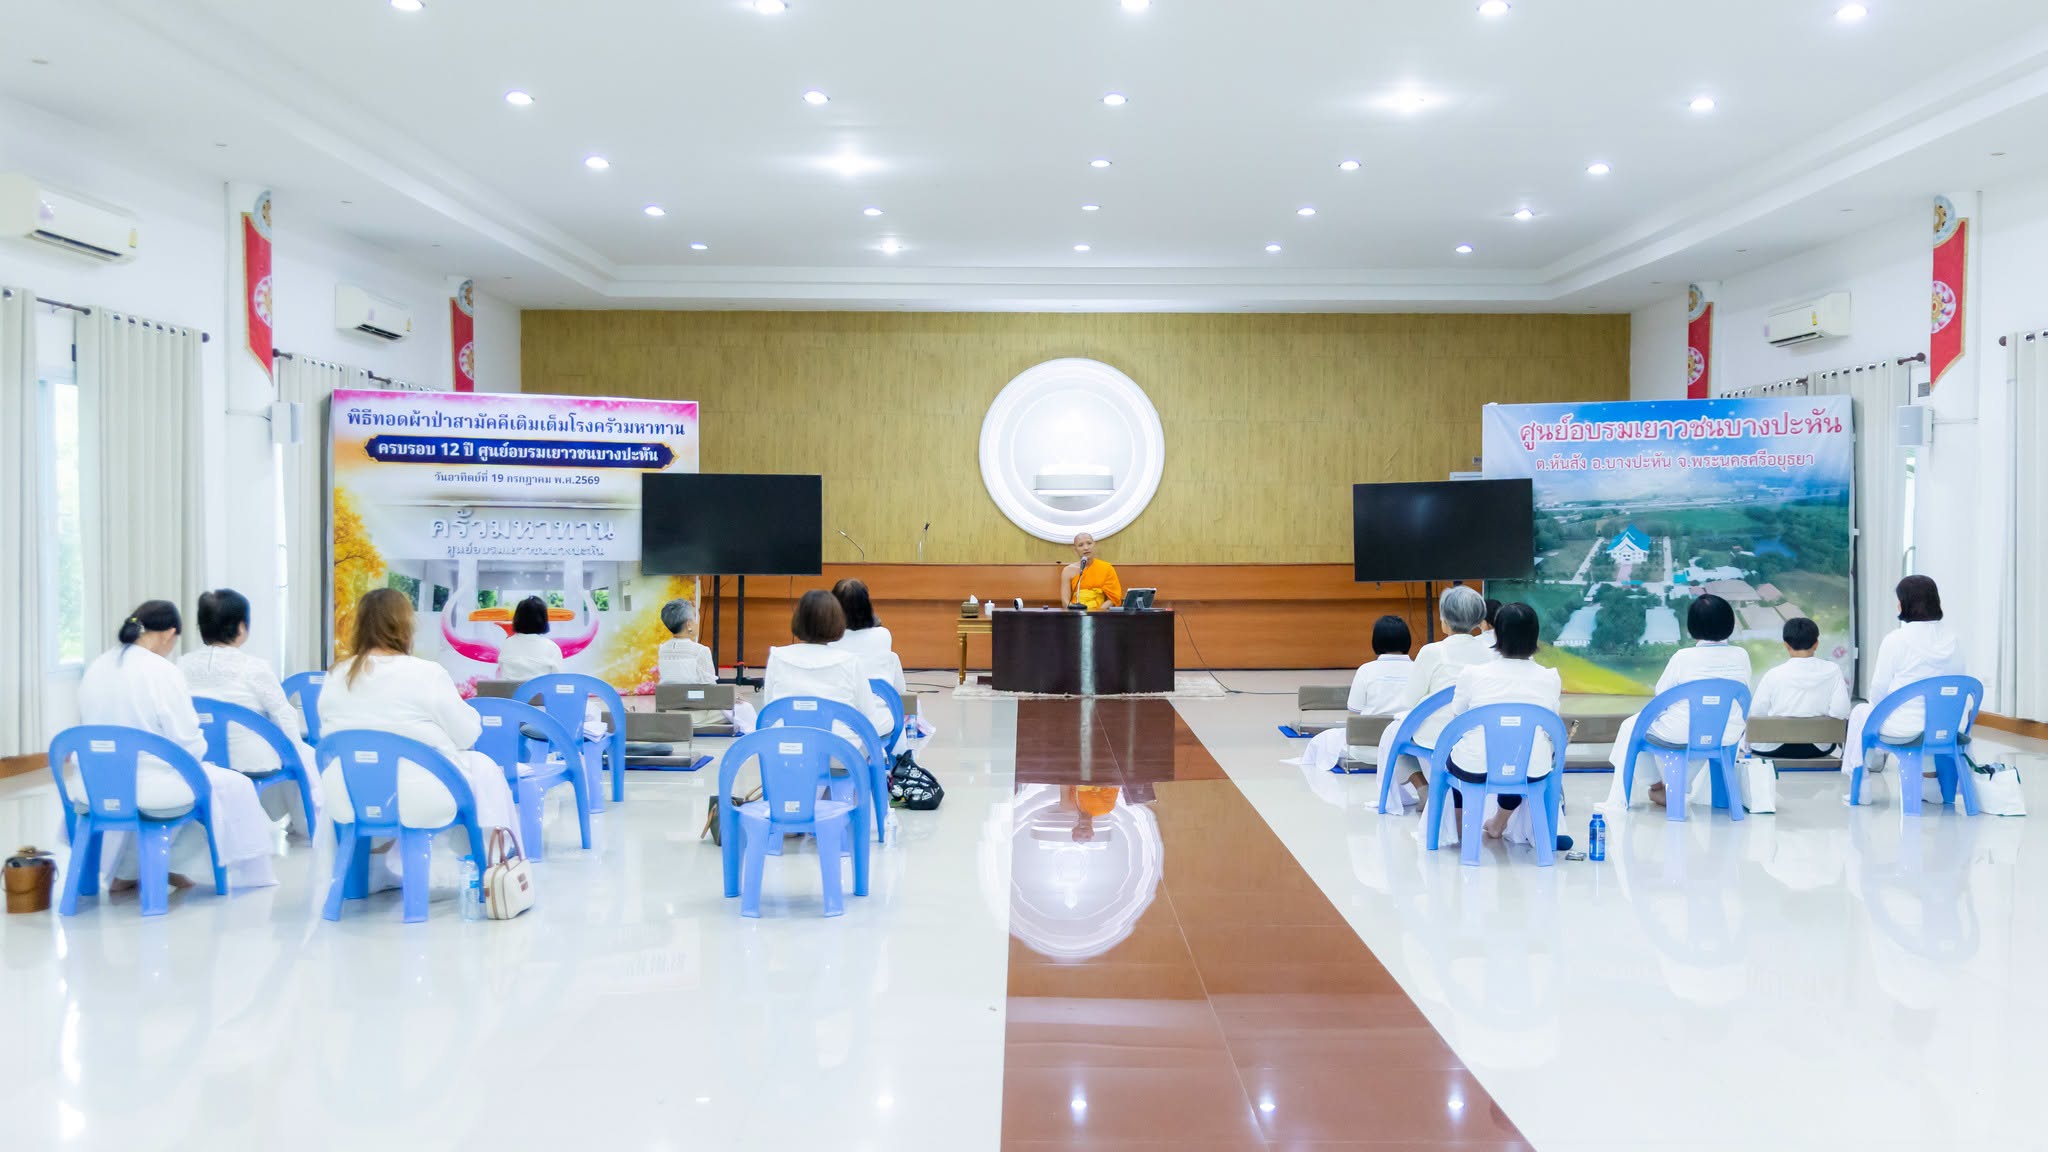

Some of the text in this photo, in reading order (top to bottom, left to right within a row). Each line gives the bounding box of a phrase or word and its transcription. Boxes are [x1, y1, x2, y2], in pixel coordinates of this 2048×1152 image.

[347, 407, 686, 436] พิธีทอดผ้าป่าสามัคคีเติมเต็มโรงครัวมหาทาน
[1519, 407, 1843, 451] ศูนย์อบรมเยาวชนบางปะหัน
[377, 441, 659, 462] ครบรอบ 12 ปี ศูนย์อบรมเยาวชนบางปะหัน
[1536, 450, 1815, 471] ต.หันสัง อ.บางปะหัน จ.พระนครศรีอยุธยา
[434, 469, 601, 486] วันอาทิตย์ที่ 19 กรกฎาคม พ.ศ.2569
